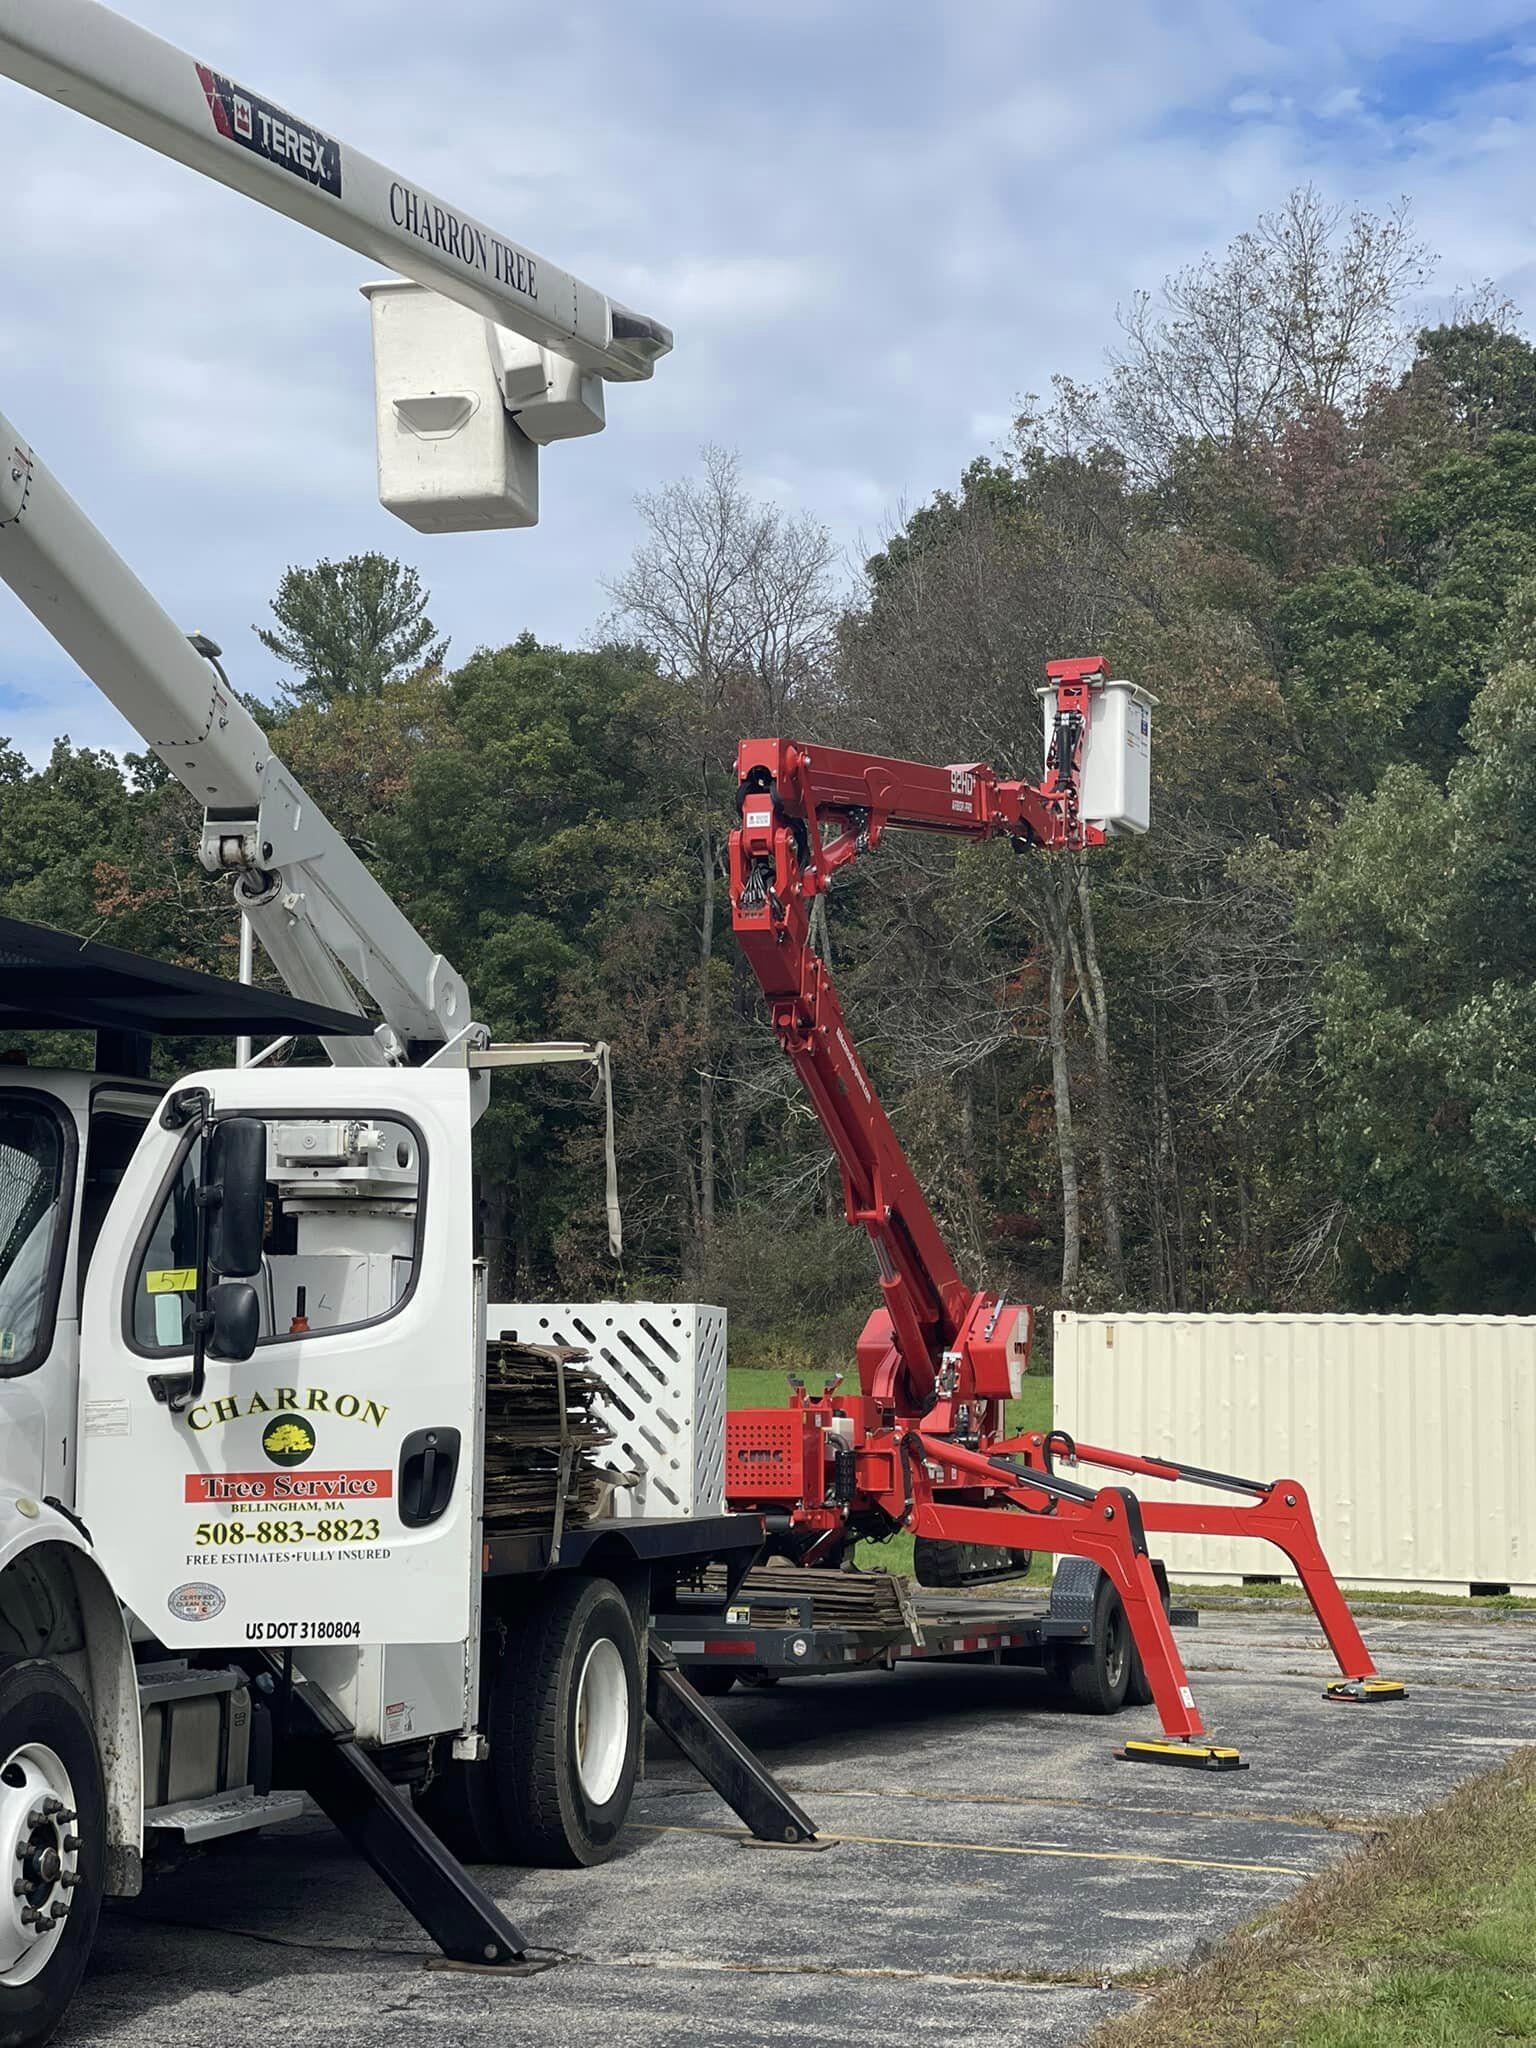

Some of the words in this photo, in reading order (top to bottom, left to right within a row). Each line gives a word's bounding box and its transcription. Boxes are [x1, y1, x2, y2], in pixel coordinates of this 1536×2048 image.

[258, 110, 326, 178] TEREX
[390, 182, 487, 273] CHARRON
[491, 238, 538, 300] TREE
[187, 1387, 389, 1431] CHARRON
[201, 1477, 266, 1499] Tree
[274, 1474, 377, 1497] Service
[231, 1502, 322, 1514] BELLINGHAM,
[324, 1501, 345, 1511] MA
[195, 1518, 381, 1546] 508-883-8823
[186, 1554, 218, 1566] FREE
[338, 1548, 391, 1561] INSURED
[246, 1622, 264, 1640] US
[266, 1622, 299, 1639] DOT
[300, 1621, 361, 1639] 3180804
